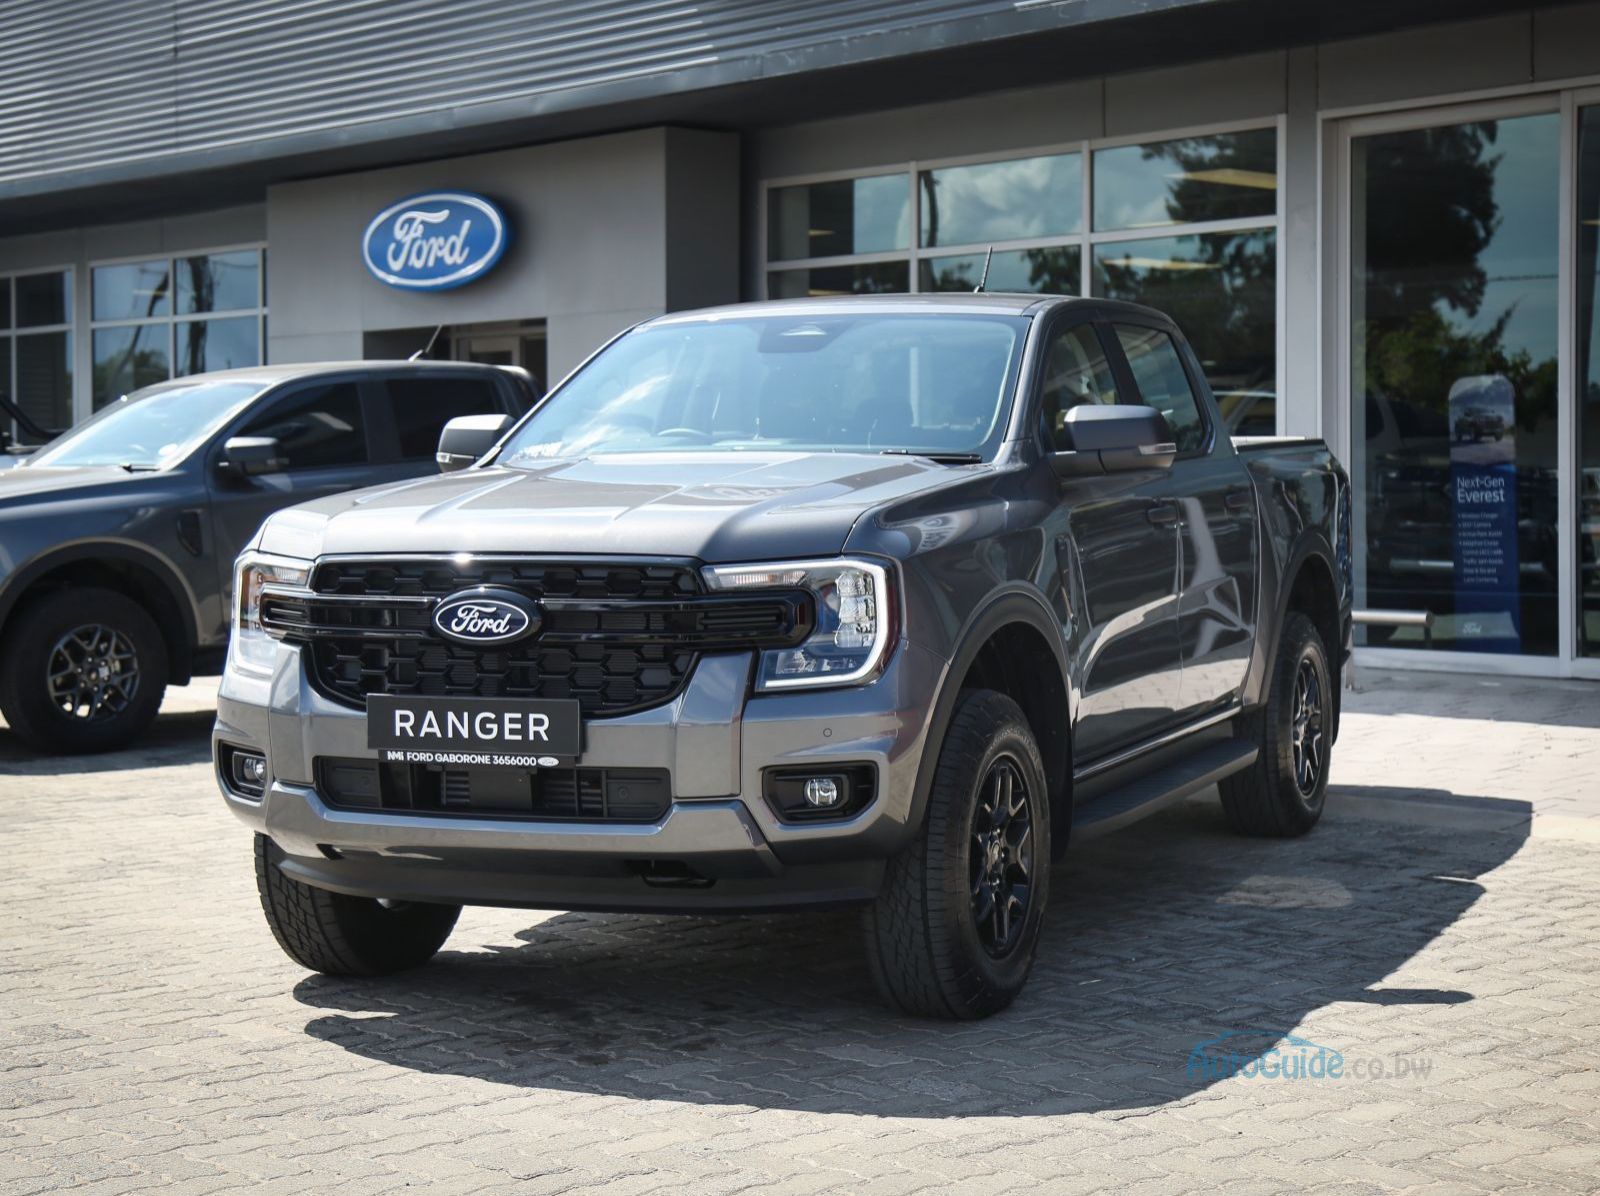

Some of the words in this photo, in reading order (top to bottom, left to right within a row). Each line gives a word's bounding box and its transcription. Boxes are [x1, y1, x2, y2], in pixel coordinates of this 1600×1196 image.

[387, 208, 472, 272] Ford
[1456, 475, 1505, 488] Next-Gen
[1457, 488, 1506, 503] Everest
[451, 604, 512, 634] Ford
[394, 709, 550, 742] RANGER
[406, 751, 434, 762] FORD
[434, 753, 491, 764] GABORONE
[492, 755, 537, 766] 3656000
